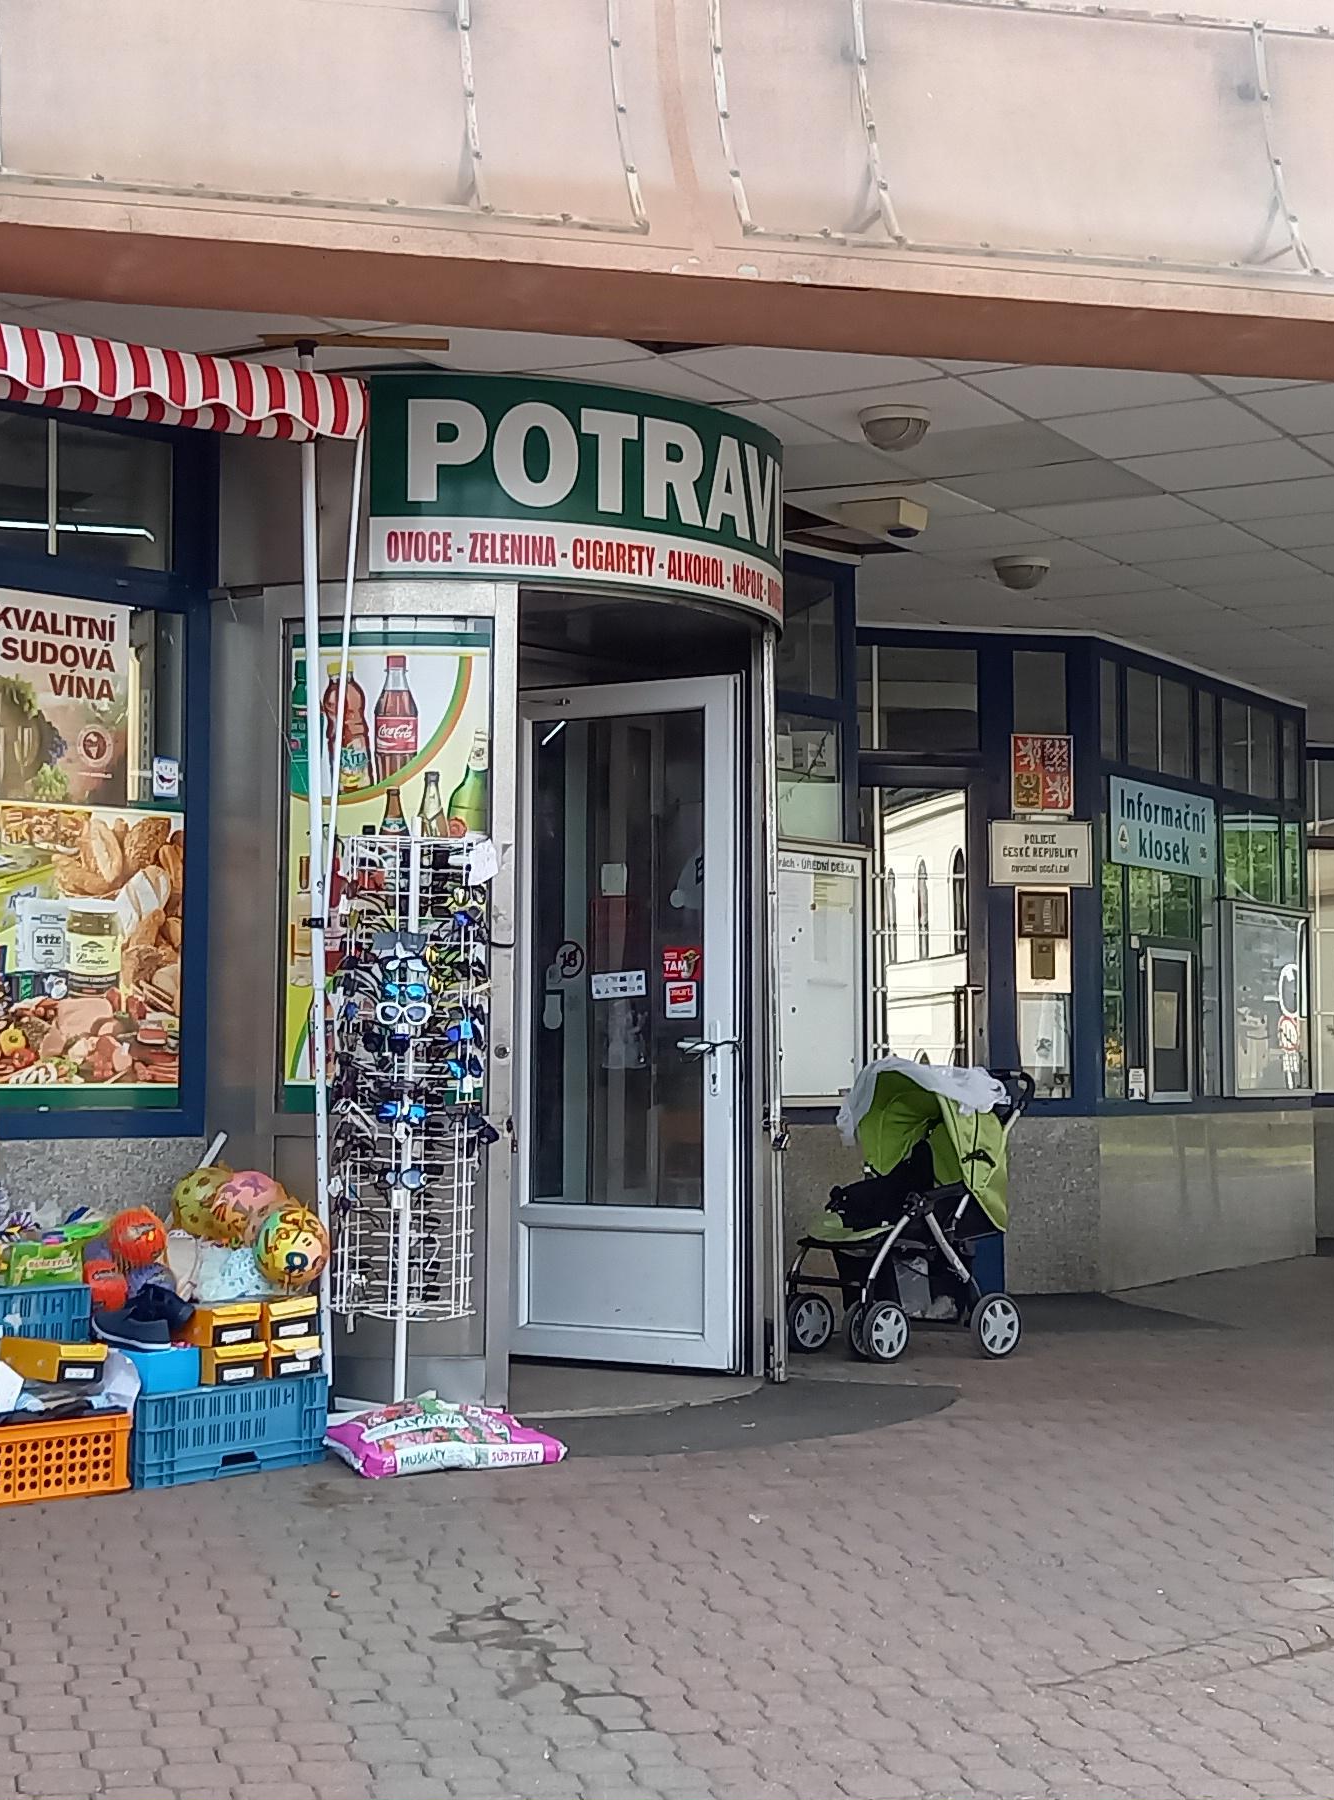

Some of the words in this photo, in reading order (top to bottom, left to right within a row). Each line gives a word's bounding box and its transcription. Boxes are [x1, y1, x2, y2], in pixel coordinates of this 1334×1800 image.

[385, 530, 453, 564] OVOCE
[468, 531, 557, 568] ZELENINA
[572, 537, 655, 577] CIGARETY
[667, 549, 725, 590] ALKOHOL
[732, 560, 764, 602] NÁPOJE
[0, 636, 116, 673] SUDOVÁ
[48, 669, 116, 702] VÍNA
[1120, 788, 1206, 834] Informační
[1002, 845, 1030, 858] ČESKÉ
[1032, 846, 1079, 859] REPUBLIKY
[1024, 834, 1057, 845] POLICIE
